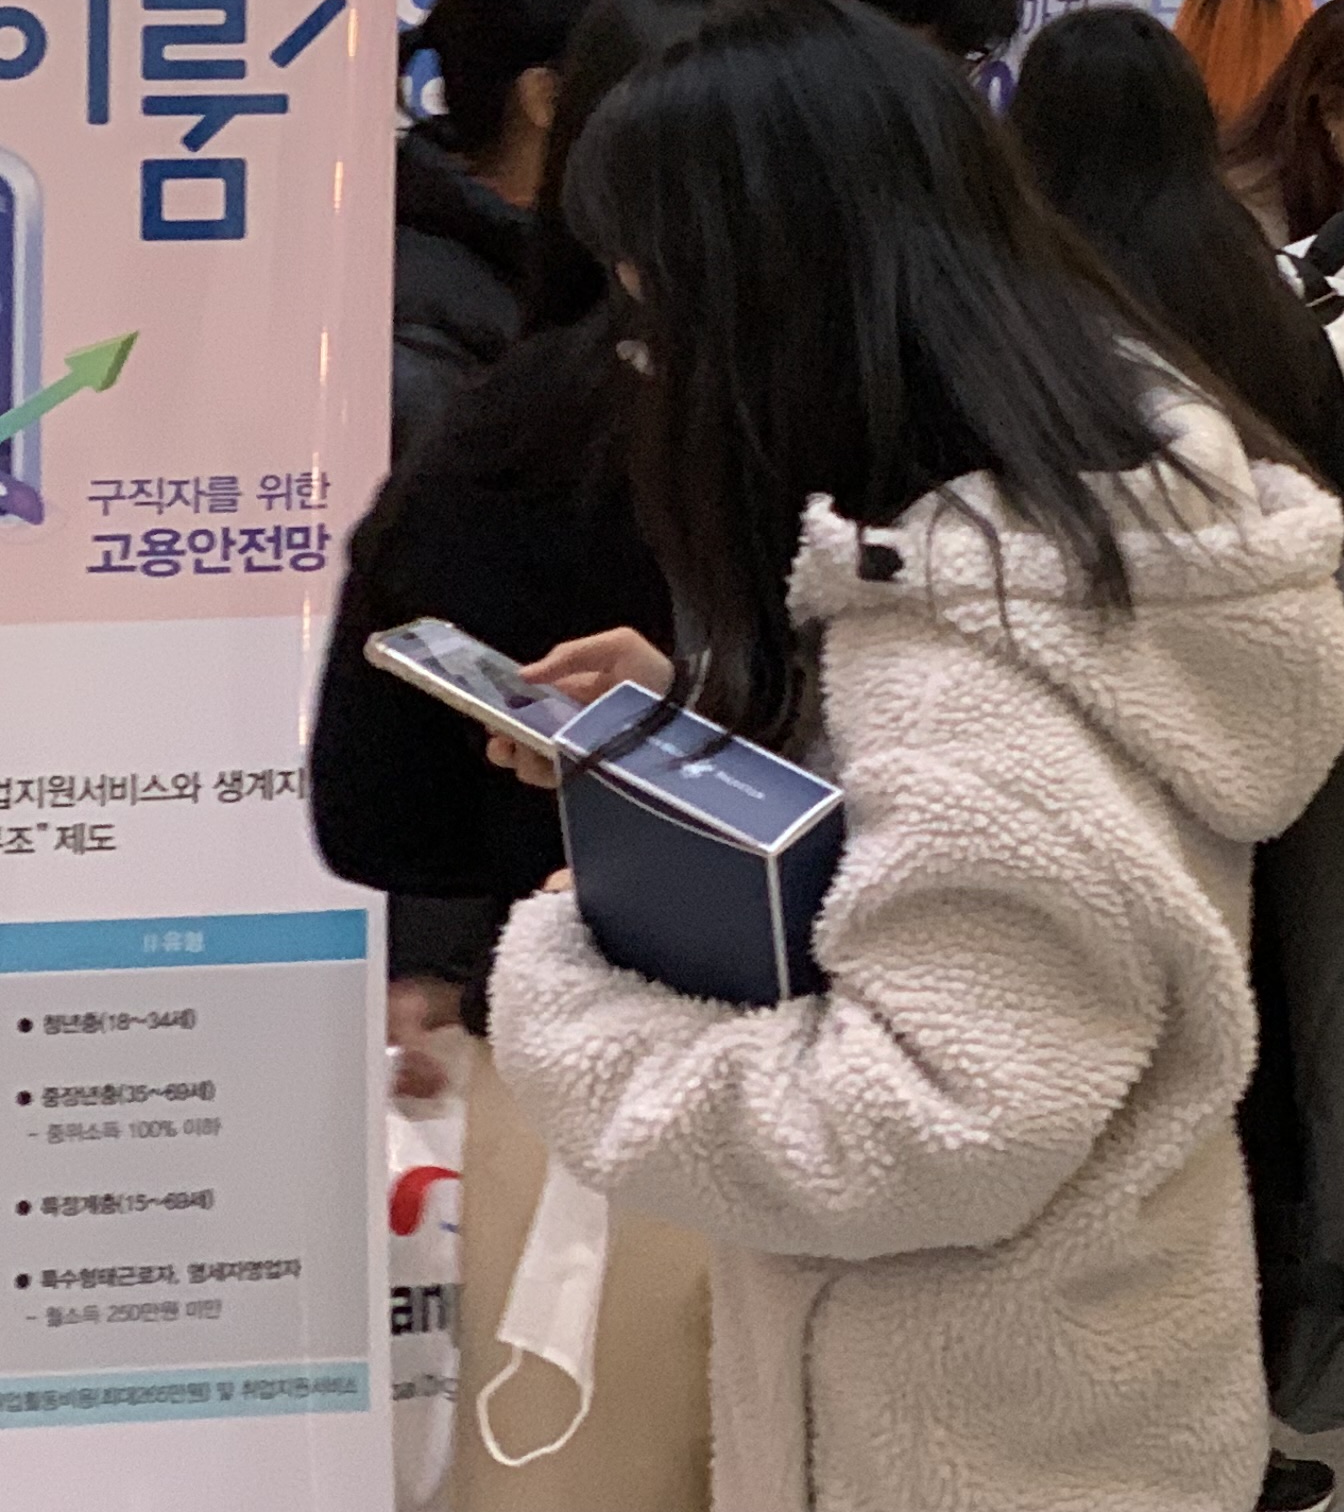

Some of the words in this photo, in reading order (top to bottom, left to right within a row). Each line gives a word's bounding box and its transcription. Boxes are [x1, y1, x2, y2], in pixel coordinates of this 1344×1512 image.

[87, 475, 243, 516] 구직자를
[256, 471, 331, 511] 위한
[86, 526, 332, 578] 고용안전망
[54, 821, 117, 855] 제도
